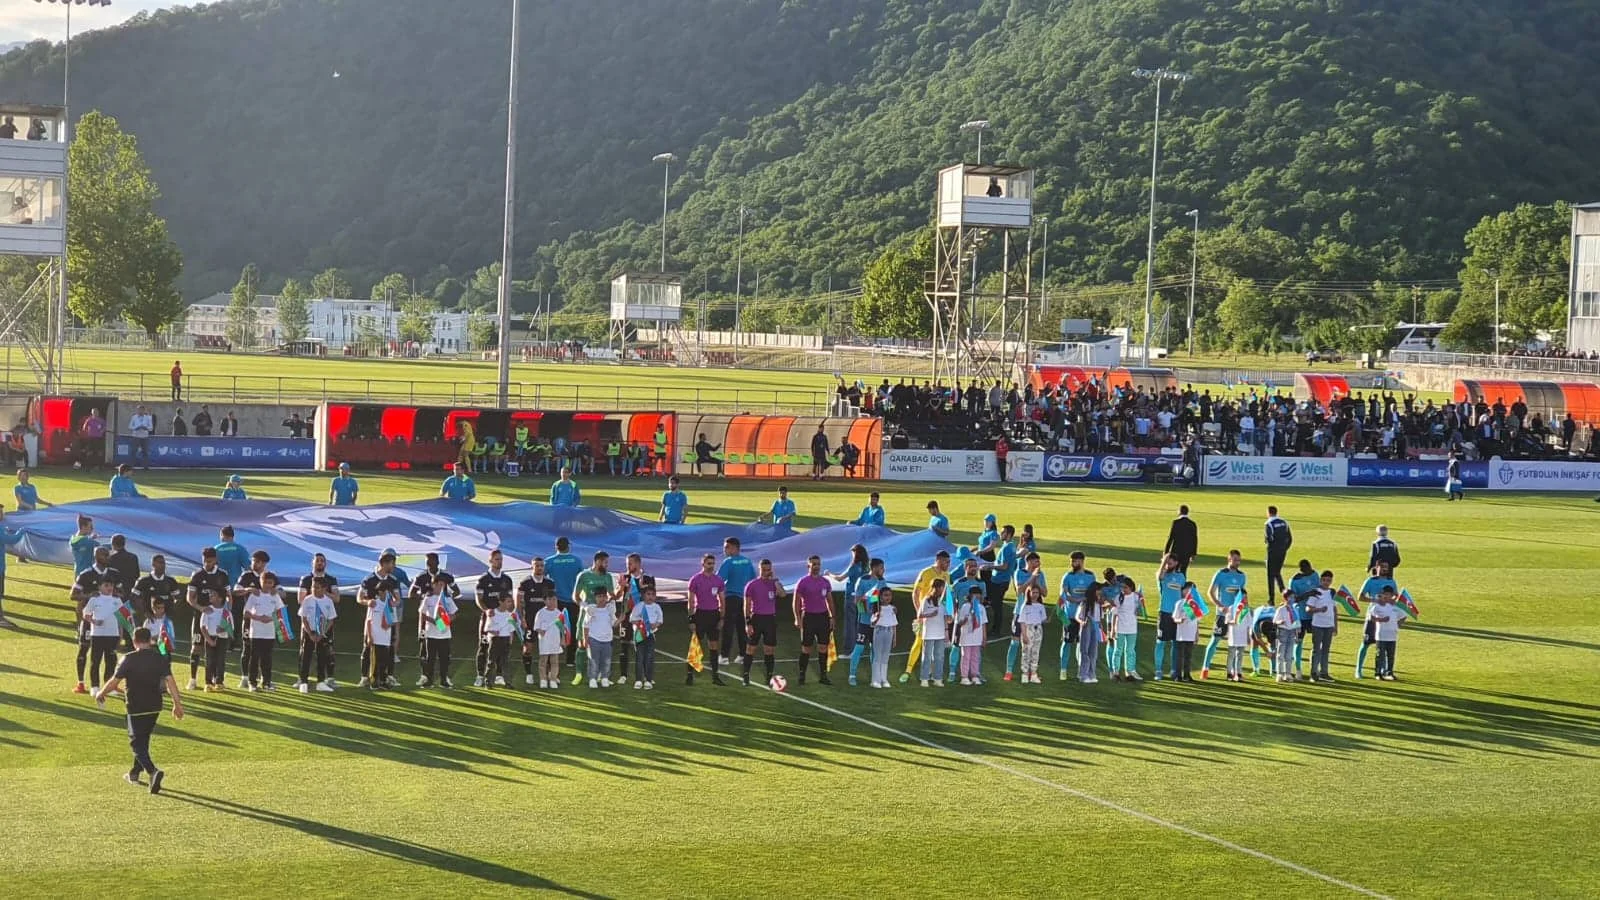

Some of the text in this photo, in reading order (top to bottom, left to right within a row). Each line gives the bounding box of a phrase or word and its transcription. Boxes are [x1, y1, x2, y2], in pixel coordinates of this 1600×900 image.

[889, 454, 929, 463] QARABAĞ
[1067, 461, 1088, 471] PFL
[1120, 462, 1140, 472] PFL
[1231, 460, 1265, 474] West
[1300, 462, 1334, 475] West
[1518, 469, 1559, 479] FUTBOLUN
